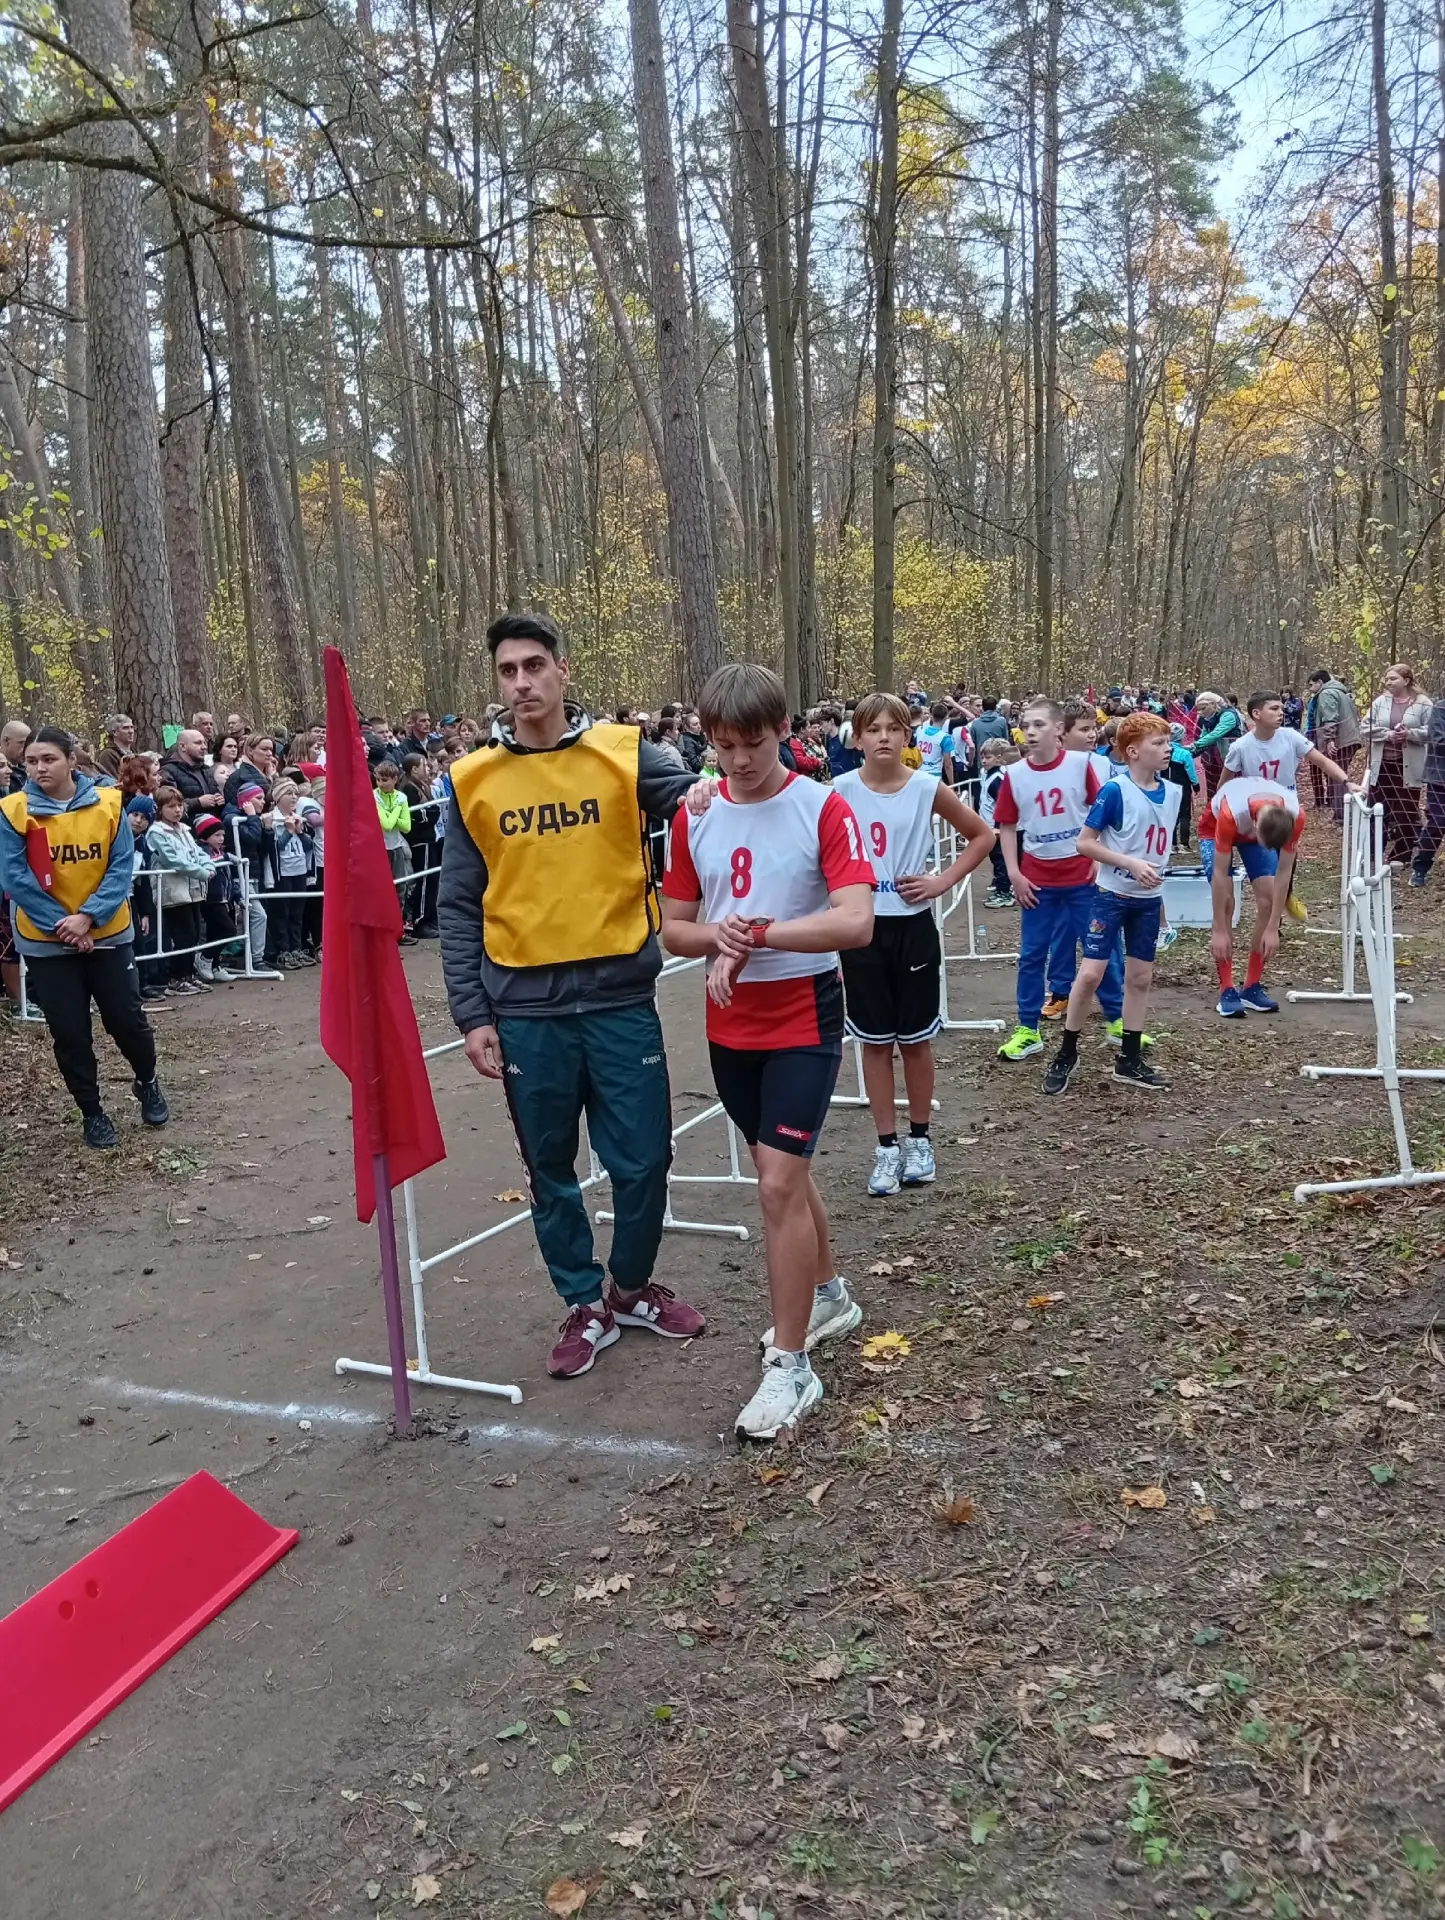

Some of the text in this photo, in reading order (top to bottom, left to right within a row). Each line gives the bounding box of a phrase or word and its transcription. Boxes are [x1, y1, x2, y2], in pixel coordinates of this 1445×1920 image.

[1259, 760, 1280, 781] 17
[499, 798, 600, 836] СУДЬЯ
[1034, 787, 1065, 817] 12
[49, 842, 102, 865] УДЬЯ
[870, 822, 887, 857] 9
[1145, 824, 1167, 856] 10
[730, 847, 753, 898] 8
[642, 1054, 662, 1065] Kappa
